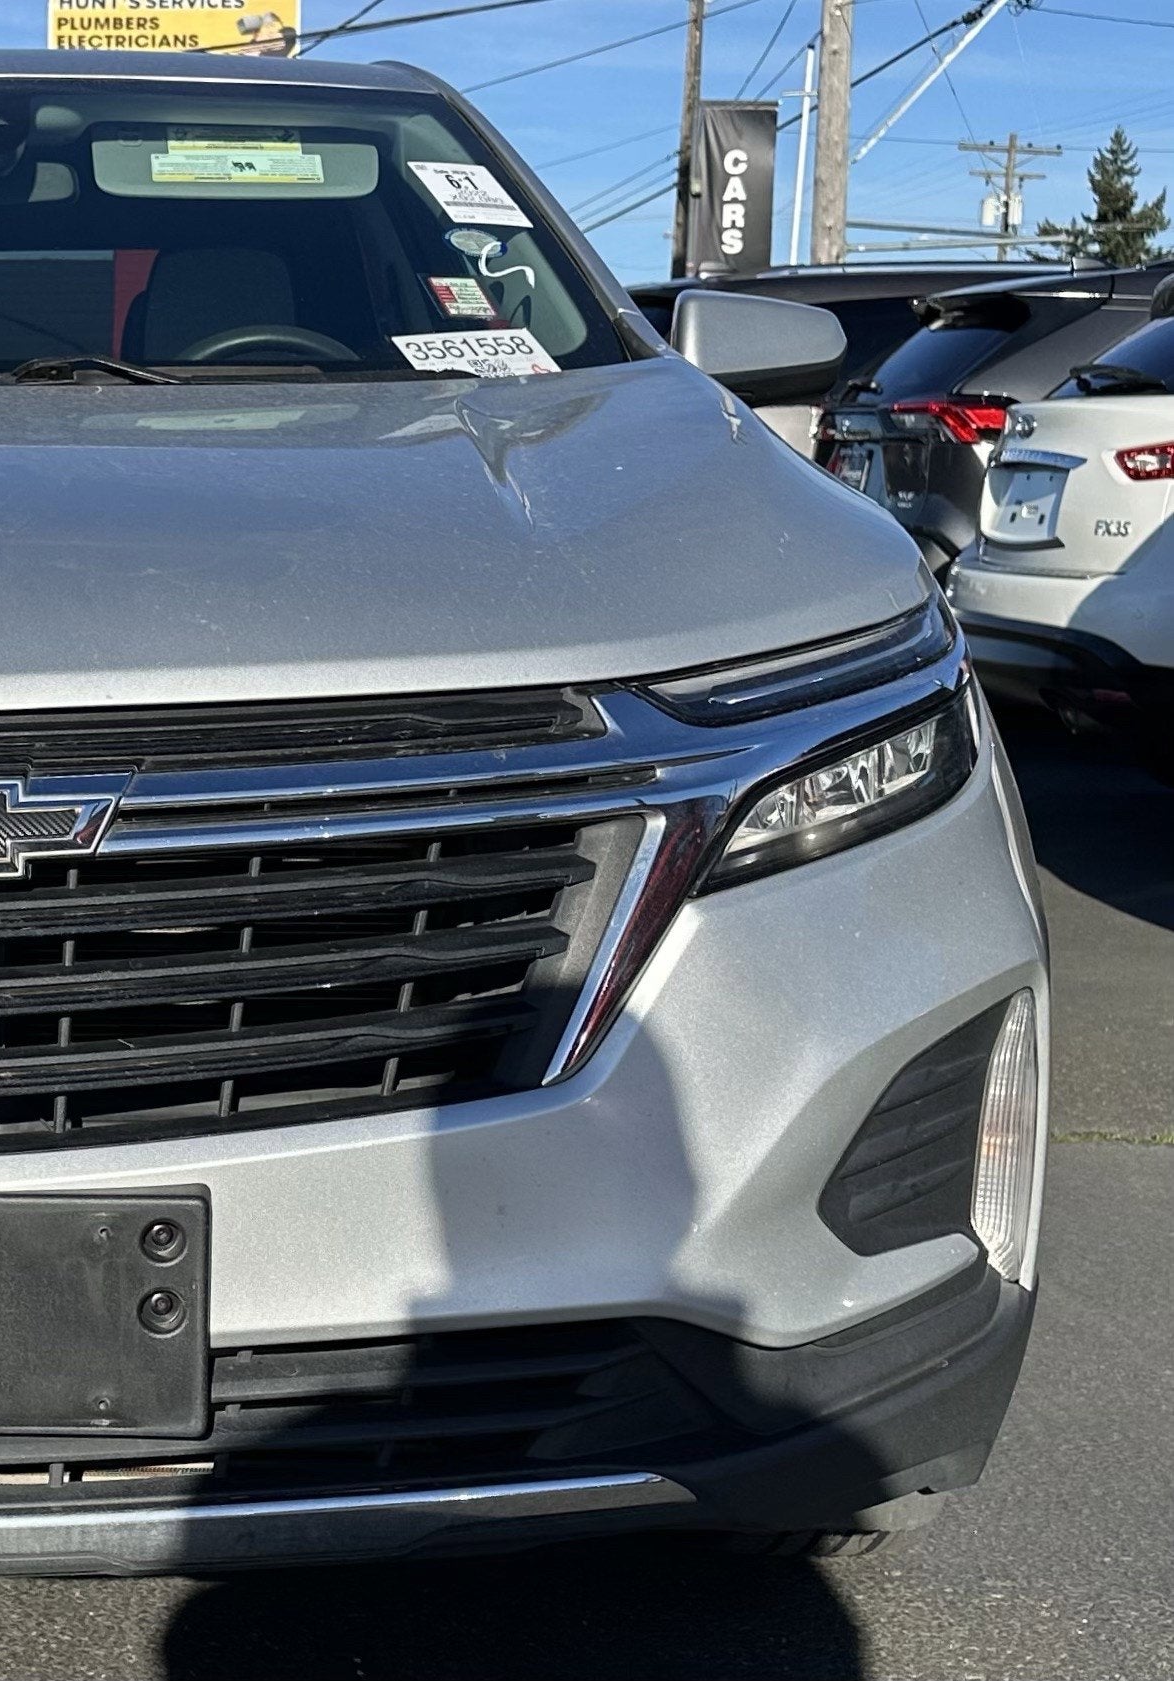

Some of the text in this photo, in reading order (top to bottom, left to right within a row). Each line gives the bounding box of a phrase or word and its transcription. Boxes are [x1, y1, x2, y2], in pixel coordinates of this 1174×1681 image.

[145, 0, 245, 9] SERVICES
[57, 17, 160, 30] PLUMBERS
[57, 34, 199, 48] ELECTRICIANS
[721, 149, 748, 255] CARS
[405, 336, 534, 361] 3561558
